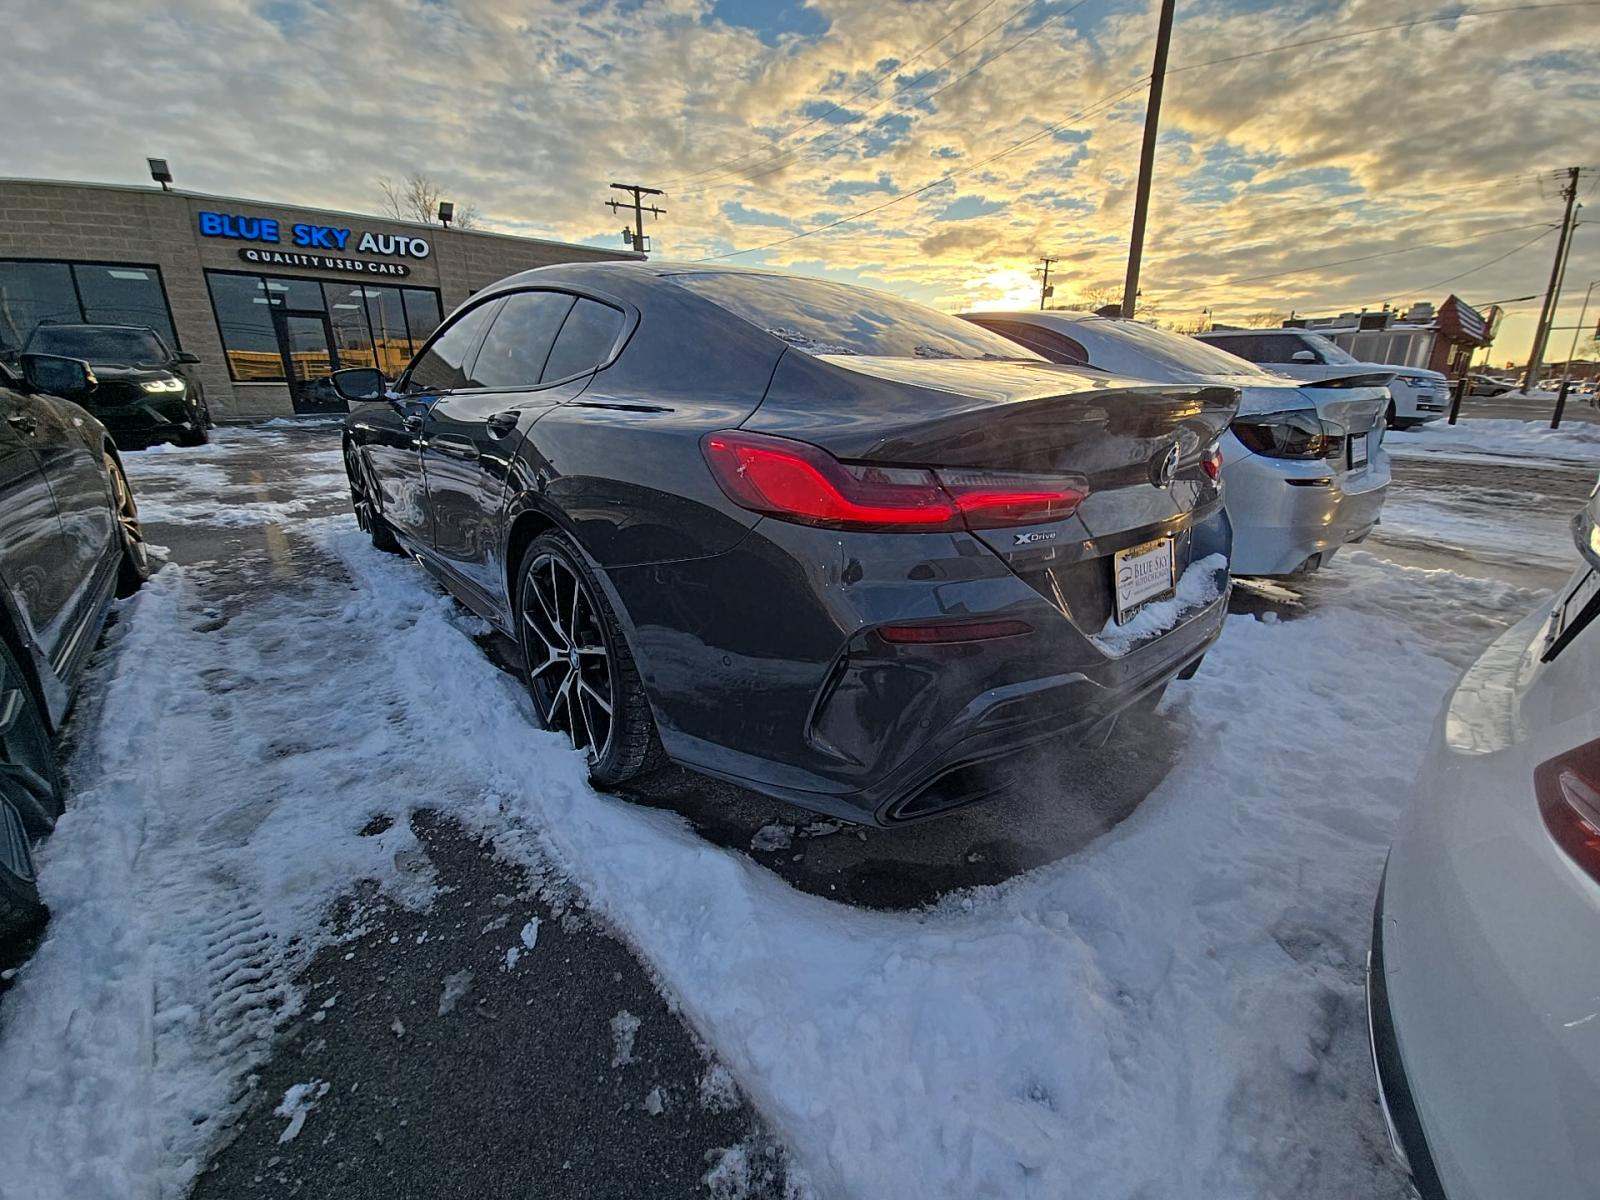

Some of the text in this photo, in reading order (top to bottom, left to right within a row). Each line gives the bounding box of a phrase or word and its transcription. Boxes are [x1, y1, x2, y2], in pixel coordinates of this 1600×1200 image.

[200, 212, 429, 258] BLUE SKY AUTO
[246, 250, 405, 275] QUALITY USED CARS
[1134, 555, 1167, 578] BLUE SKY
